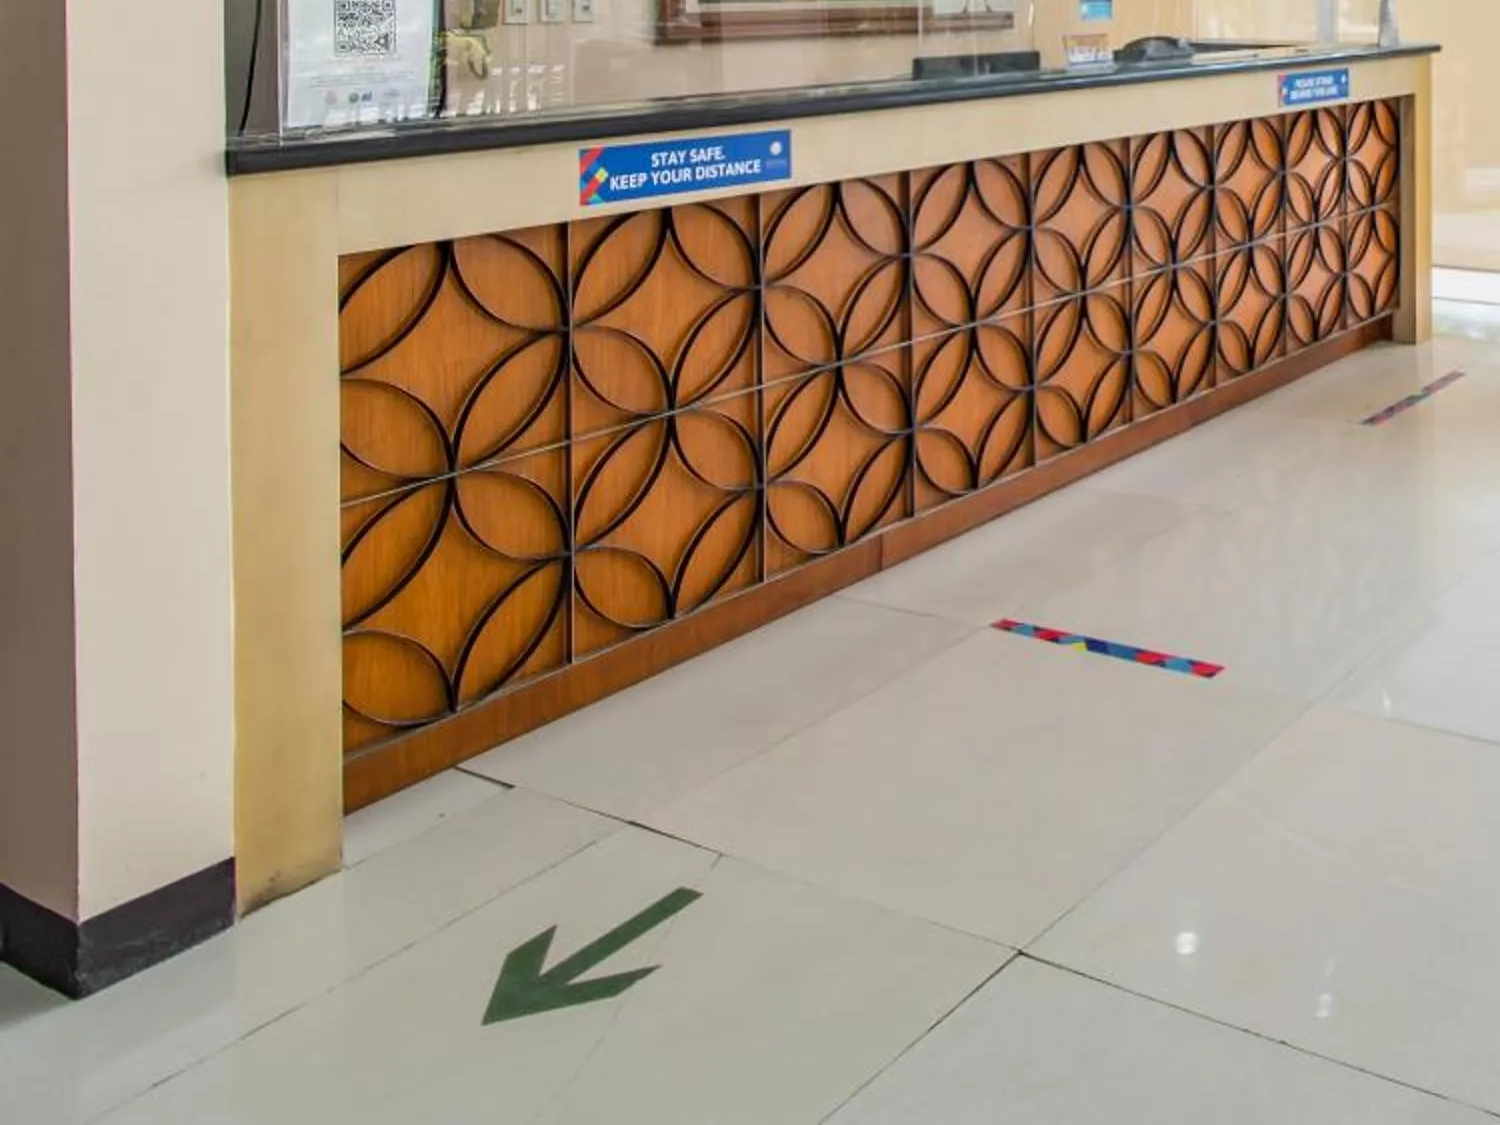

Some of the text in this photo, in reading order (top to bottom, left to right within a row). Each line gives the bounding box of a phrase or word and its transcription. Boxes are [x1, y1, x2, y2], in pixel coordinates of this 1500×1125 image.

[651, 150, 687, 168] STAY
[609, 173, 648, 191] KEEP
[651, 167, 693, 186] YOUR
[695, 159, 761, 181] DISTANCE
